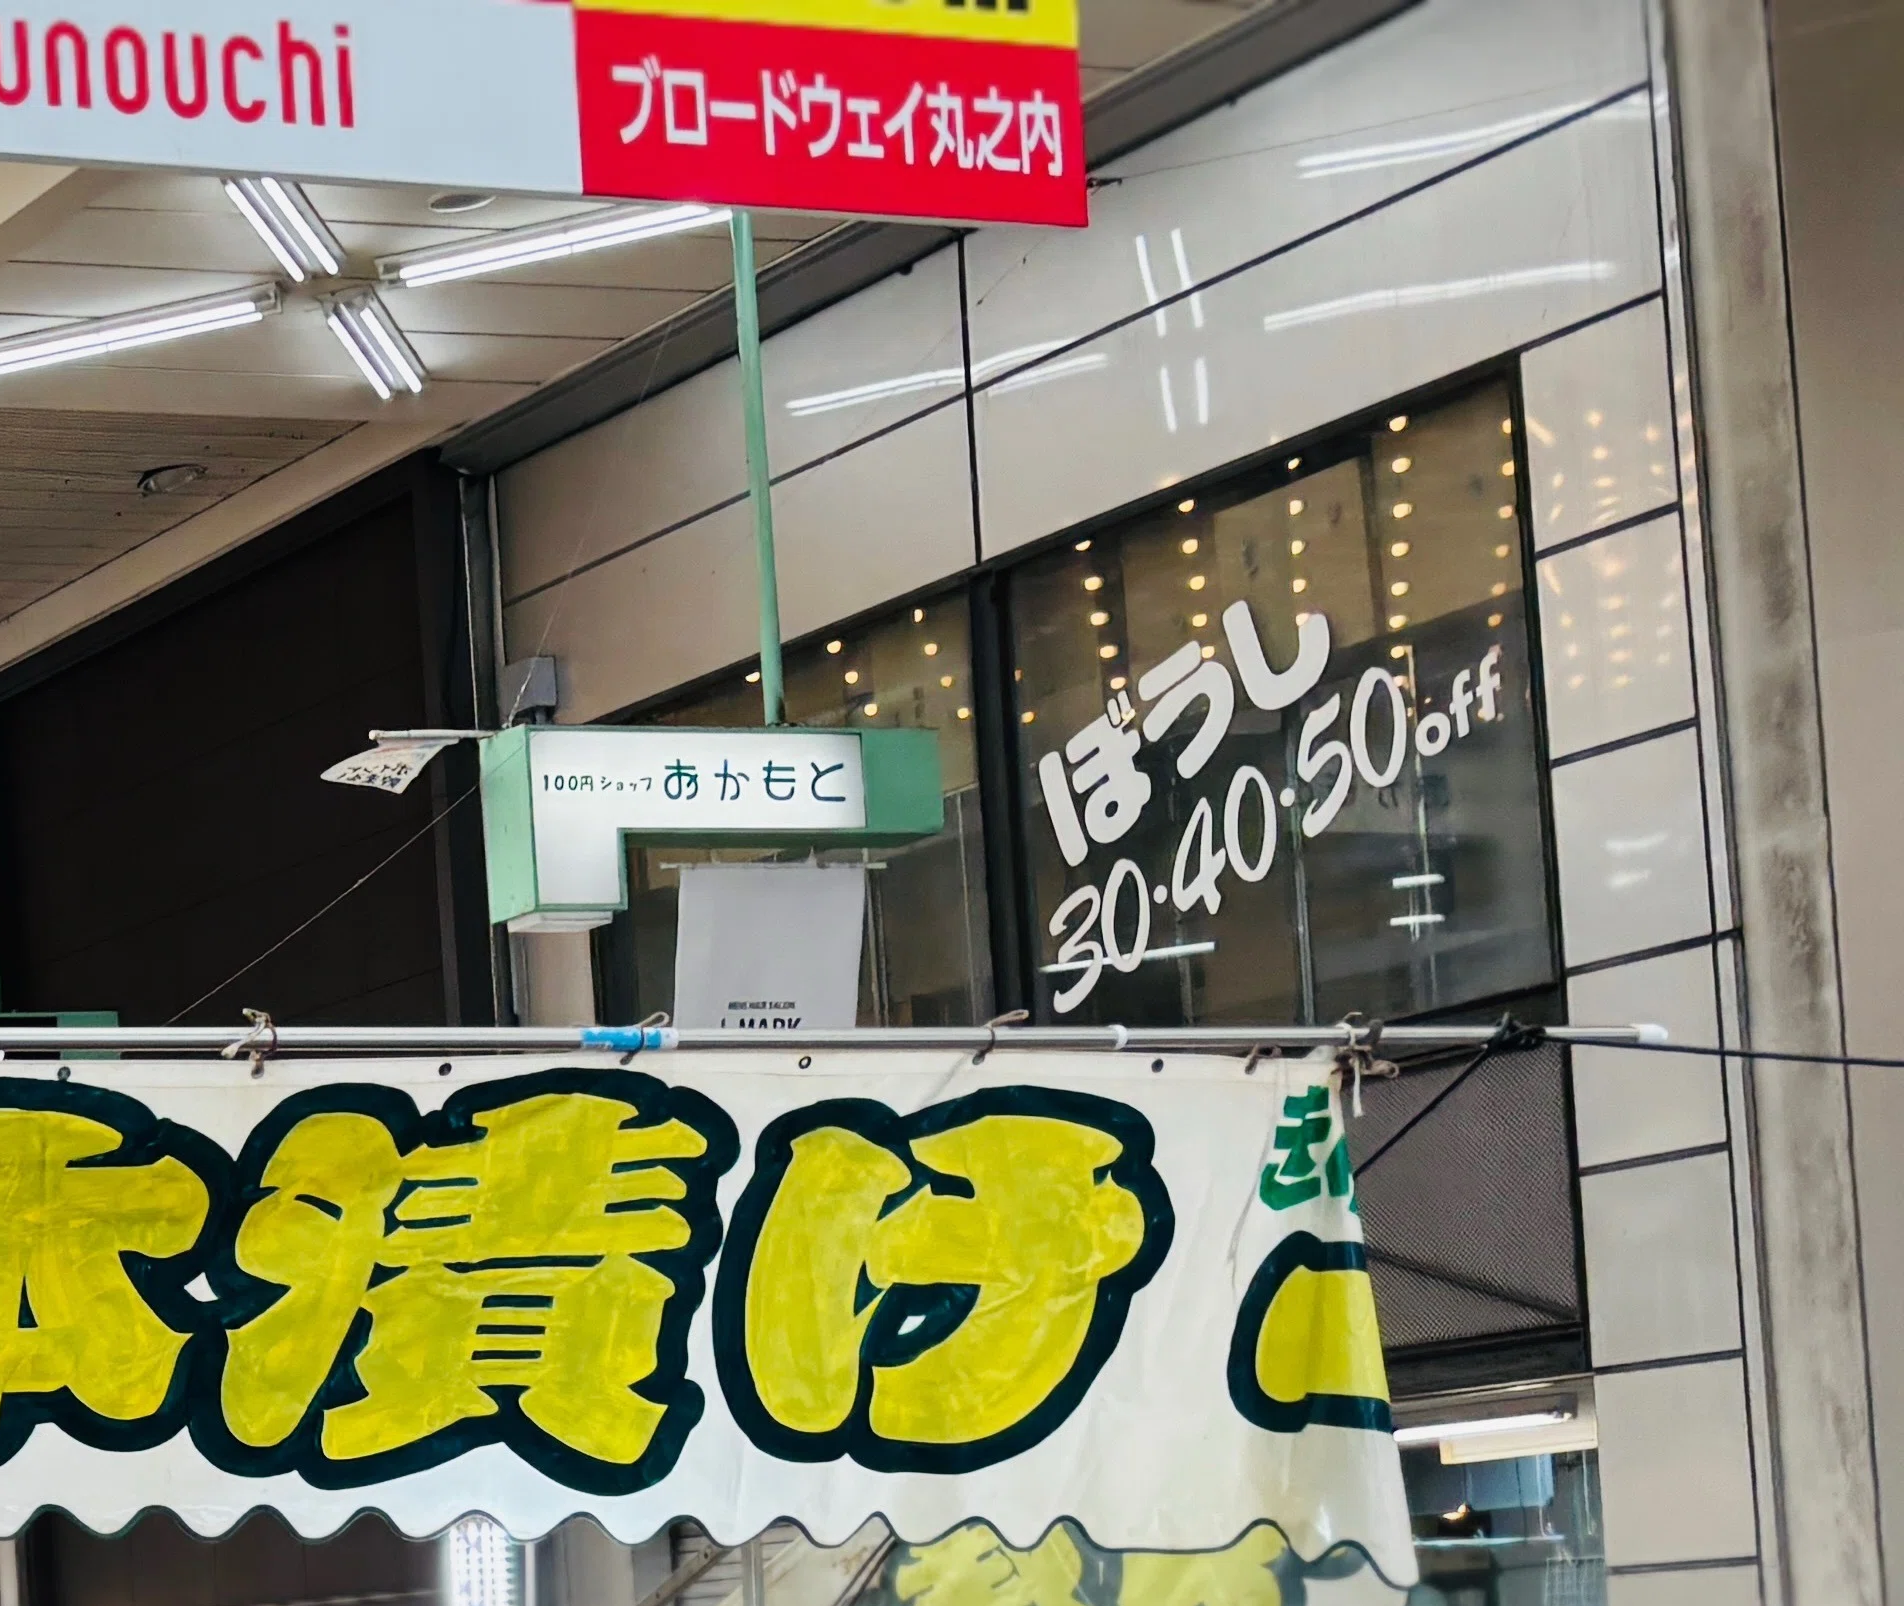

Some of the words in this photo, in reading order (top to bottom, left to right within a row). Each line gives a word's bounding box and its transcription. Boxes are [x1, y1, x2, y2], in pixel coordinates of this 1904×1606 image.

[612, 55, 1064, 176] ブロードウェイ丸之内
[663, 758, 846, 801] おかもと
[1038, 600, 1331, 867] ぼうし
